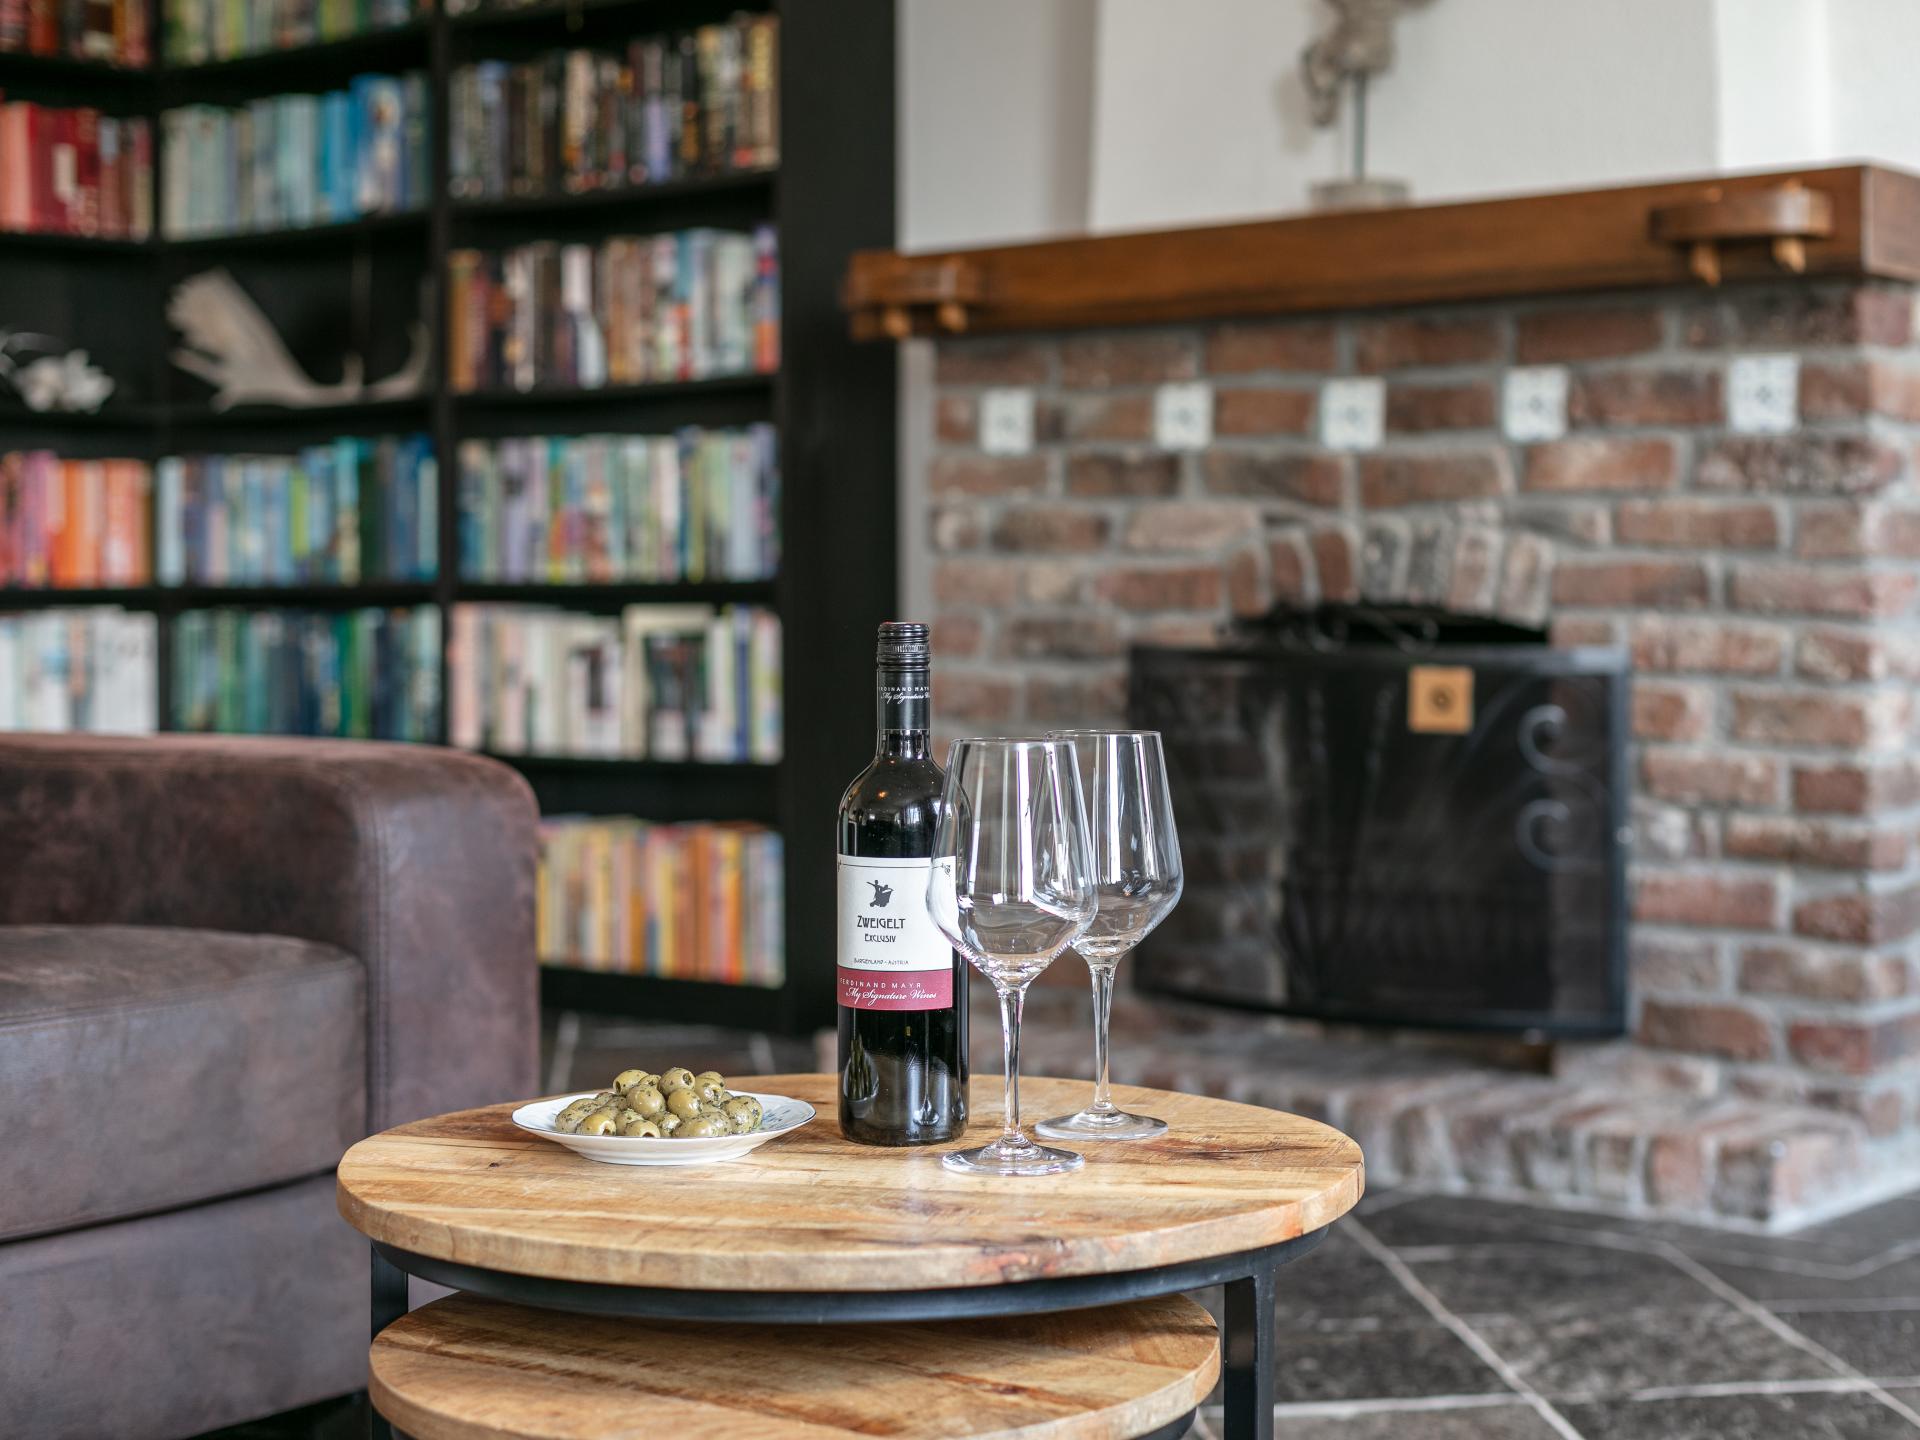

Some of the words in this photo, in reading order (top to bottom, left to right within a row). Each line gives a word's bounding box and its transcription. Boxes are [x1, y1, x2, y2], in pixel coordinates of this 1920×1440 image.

[857, 915, 906, 929] ZWEIGELT
[840, 977, 886, 989] FERDINAND
[845, 986, 861, 1004] My
[862, 988, 907, 1006] Signature
[910, 988, 937, 999] Wines
